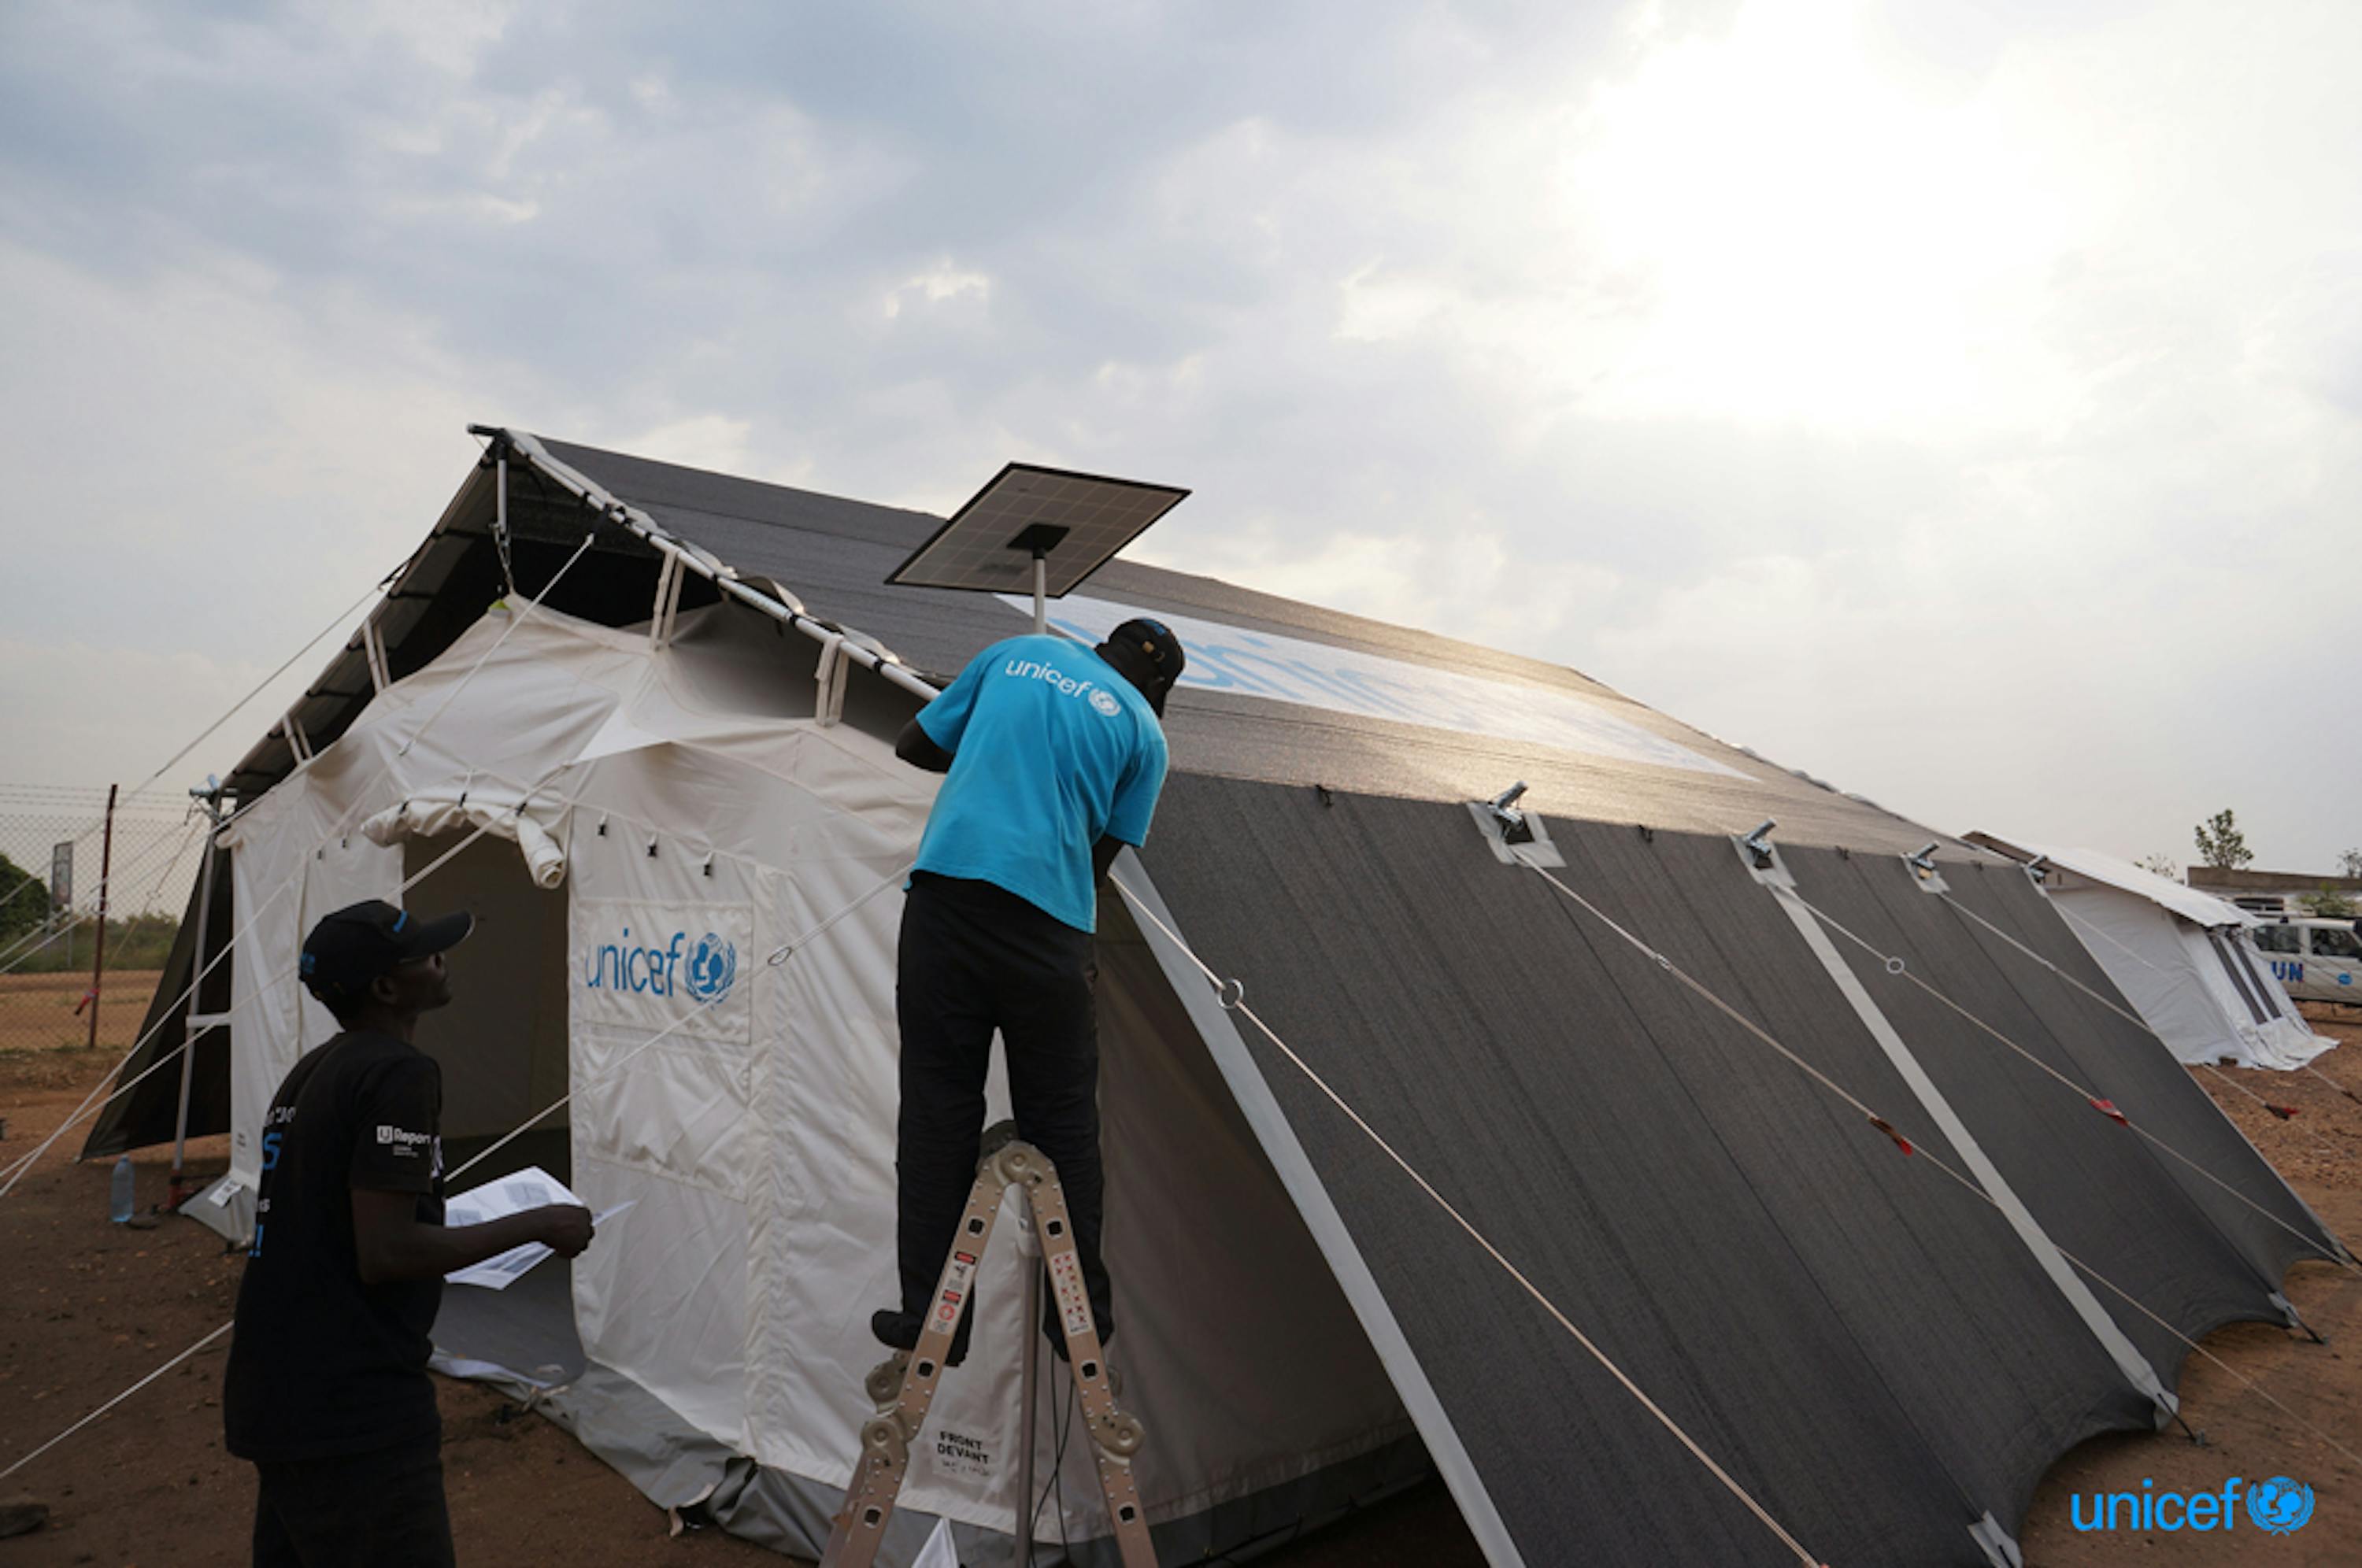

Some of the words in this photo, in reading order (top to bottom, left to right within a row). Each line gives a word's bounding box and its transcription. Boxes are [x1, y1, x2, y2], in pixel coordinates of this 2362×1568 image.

[1005, 660, 1093, 698] unicef
[585, 927, 685, 997] unicef
[2271, 960, 2304, 982] UN
